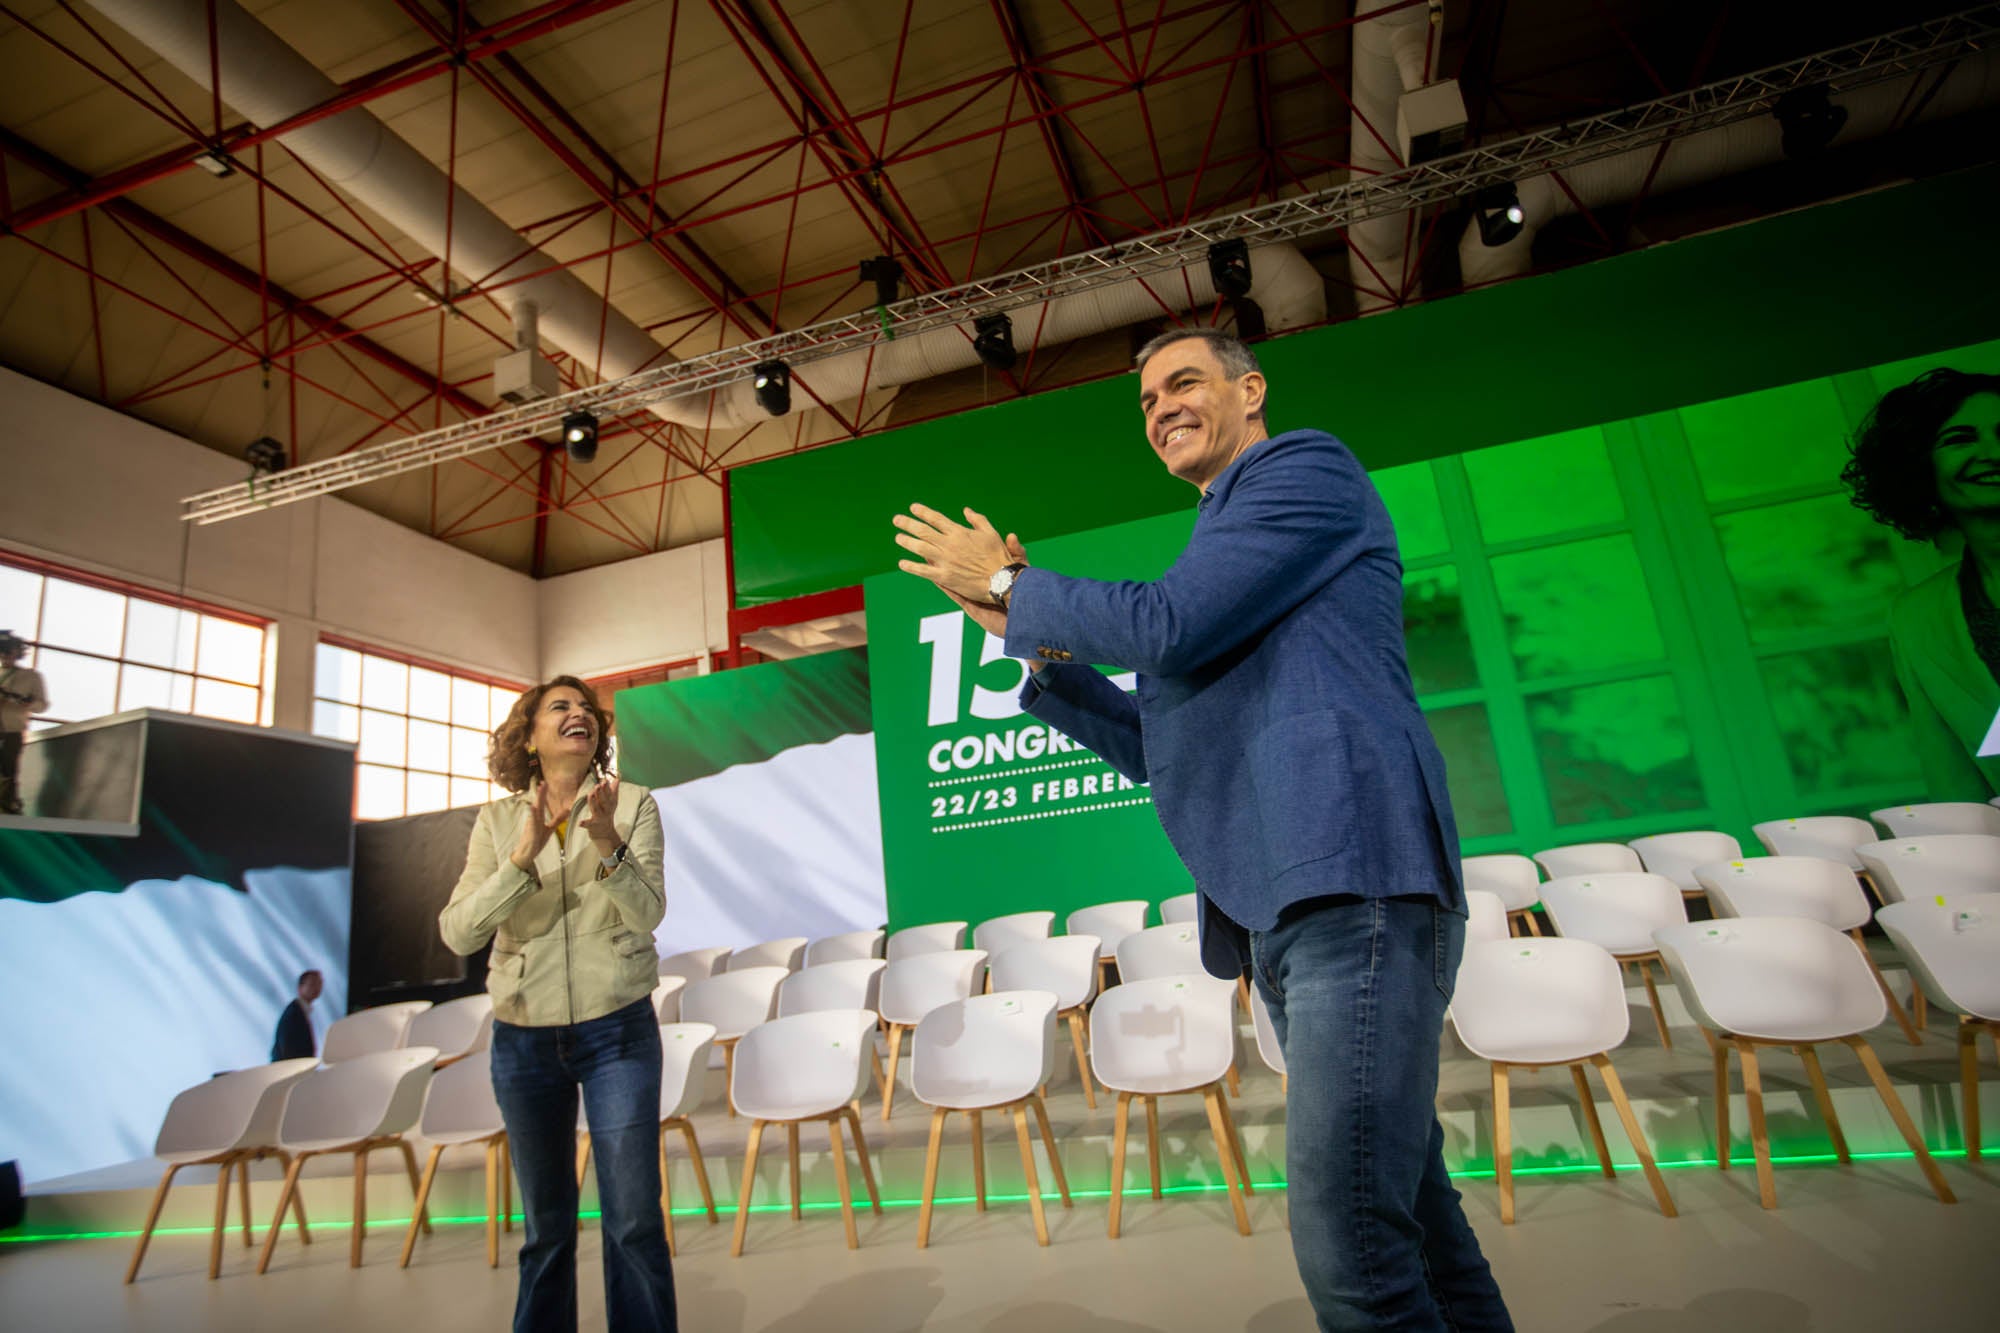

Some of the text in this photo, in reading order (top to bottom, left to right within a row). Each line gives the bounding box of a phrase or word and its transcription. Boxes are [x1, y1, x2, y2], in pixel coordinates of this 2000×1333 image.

[928, 725, 1088, 773] CONGR
[932, 772, 1150, 818] 22/23 FEBRER
